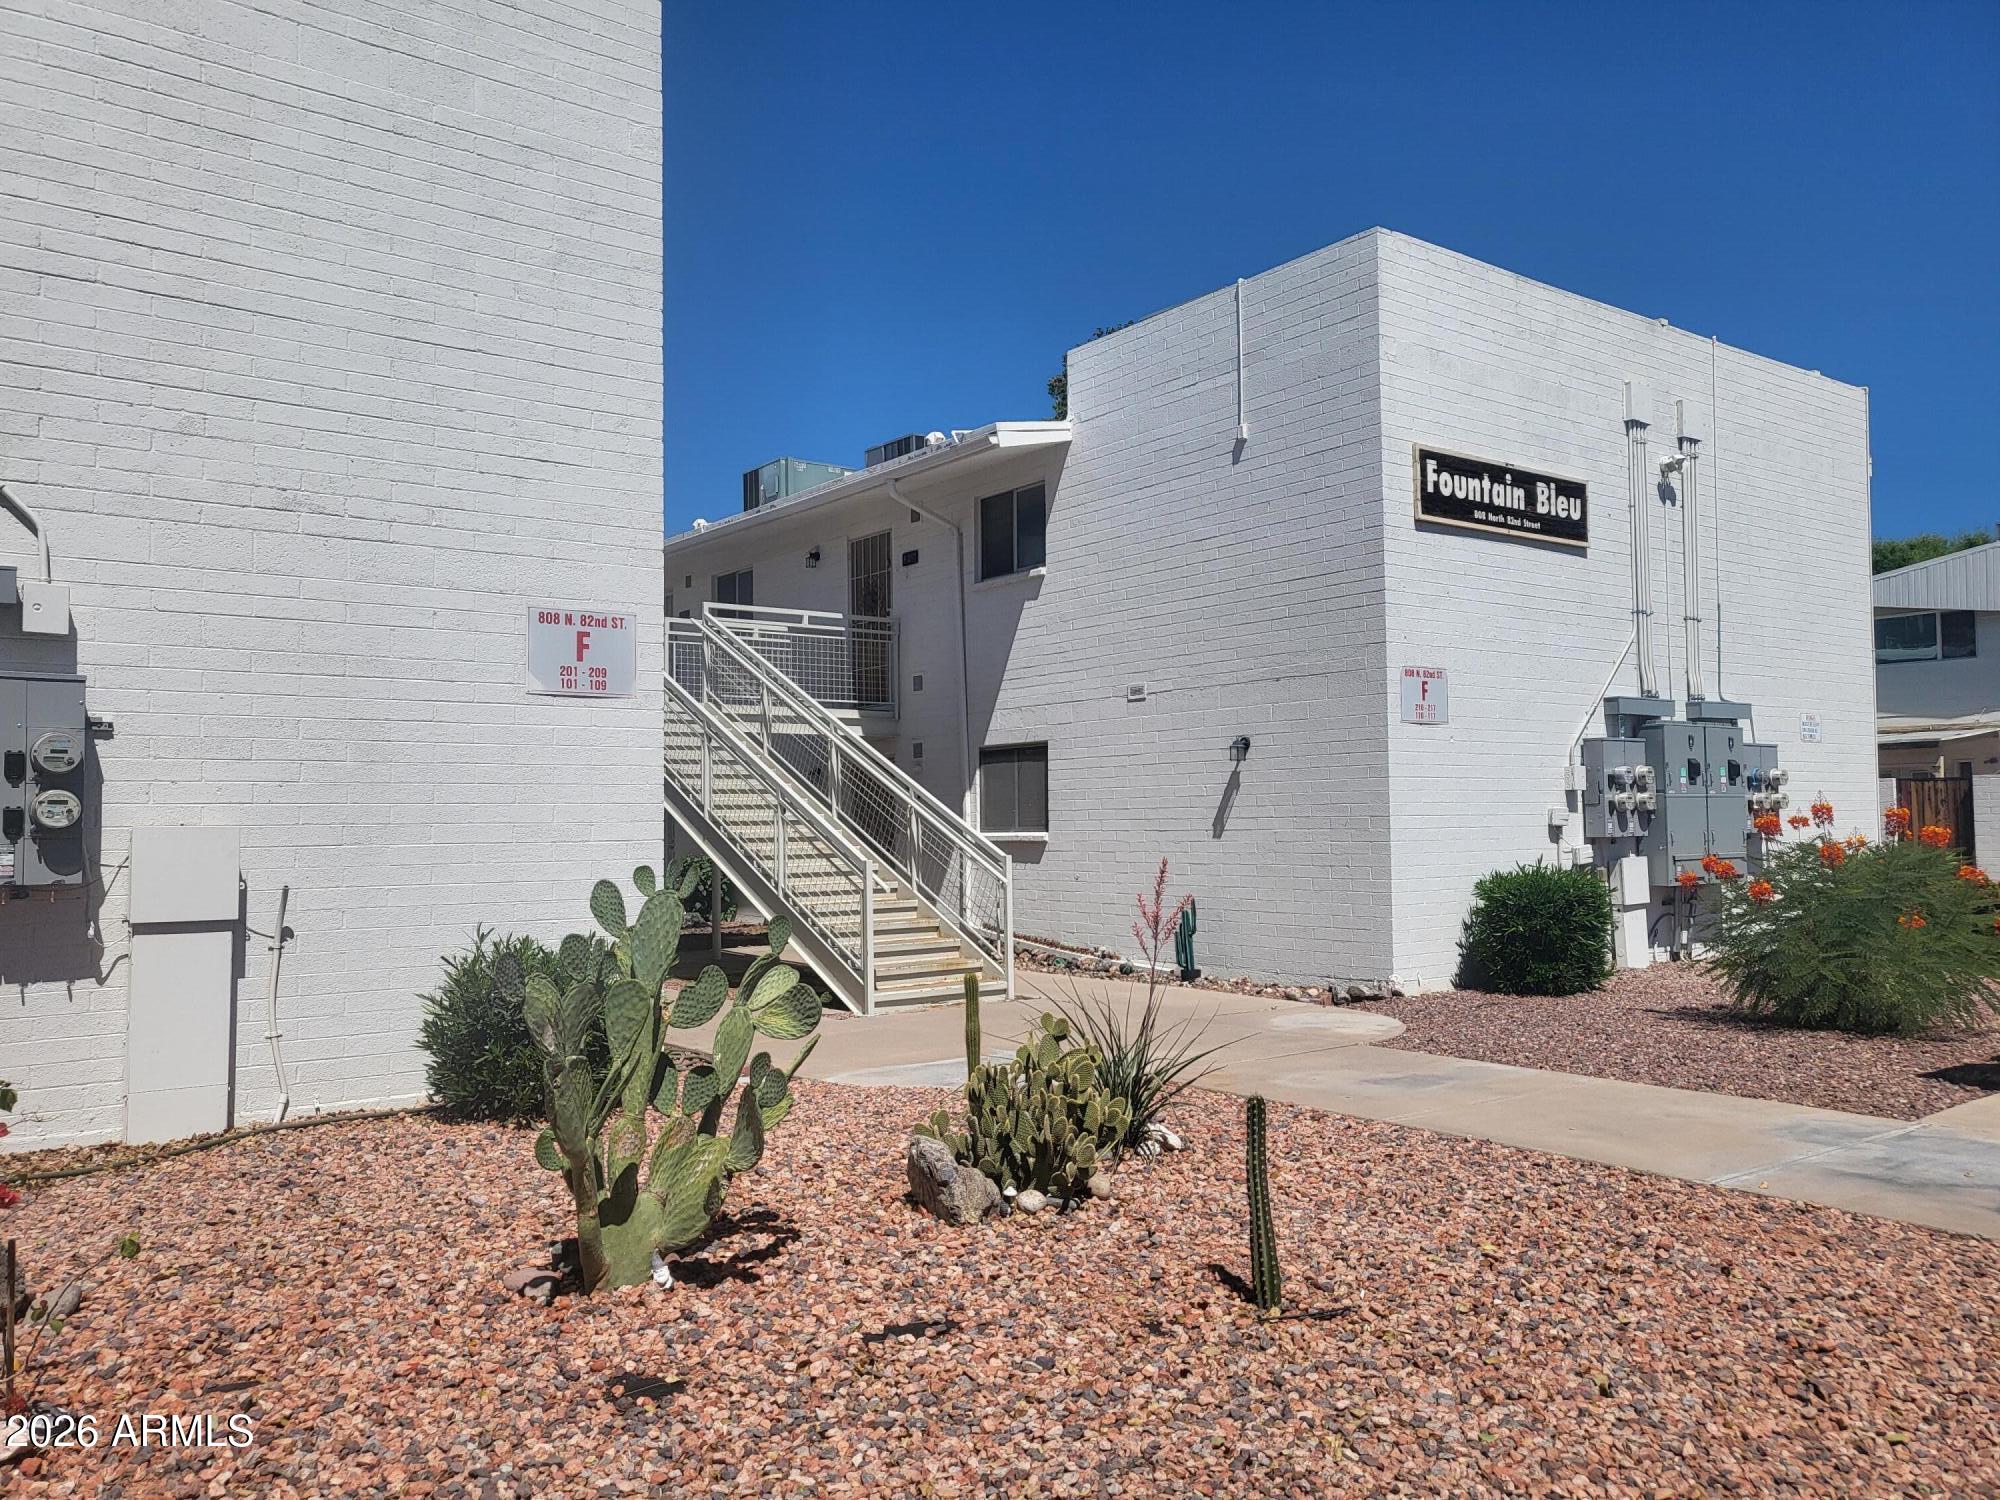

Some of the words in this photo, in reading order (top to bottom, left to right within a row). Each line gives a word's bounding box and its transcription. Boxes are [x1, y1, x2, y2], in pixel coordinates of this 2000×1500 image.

[1426, 459, 1526, 511] Fountain
[1536, 482, 1582, 521] Bleu
[1474, 510, 1486, 521] 808
[1488, 512, 1505, 523] North
[1507, 515, 1522, 526] 82nd
[1523, 517, 1541, 530] Street
[538, 611, 560, 625] 808
[564, 613, 576, 626] N.
[580, 614, 607, 629] 82nd
[611, 617, 627, 630] ST.
[576, 631, 591, 662] F
[559, 666, 578, 677] 201
[588, 667, 607, 678] 209
[560, 678, 578, 689] 101
[589, 680, 607, 691] 109
[1421, 680, 1428, 701] F
